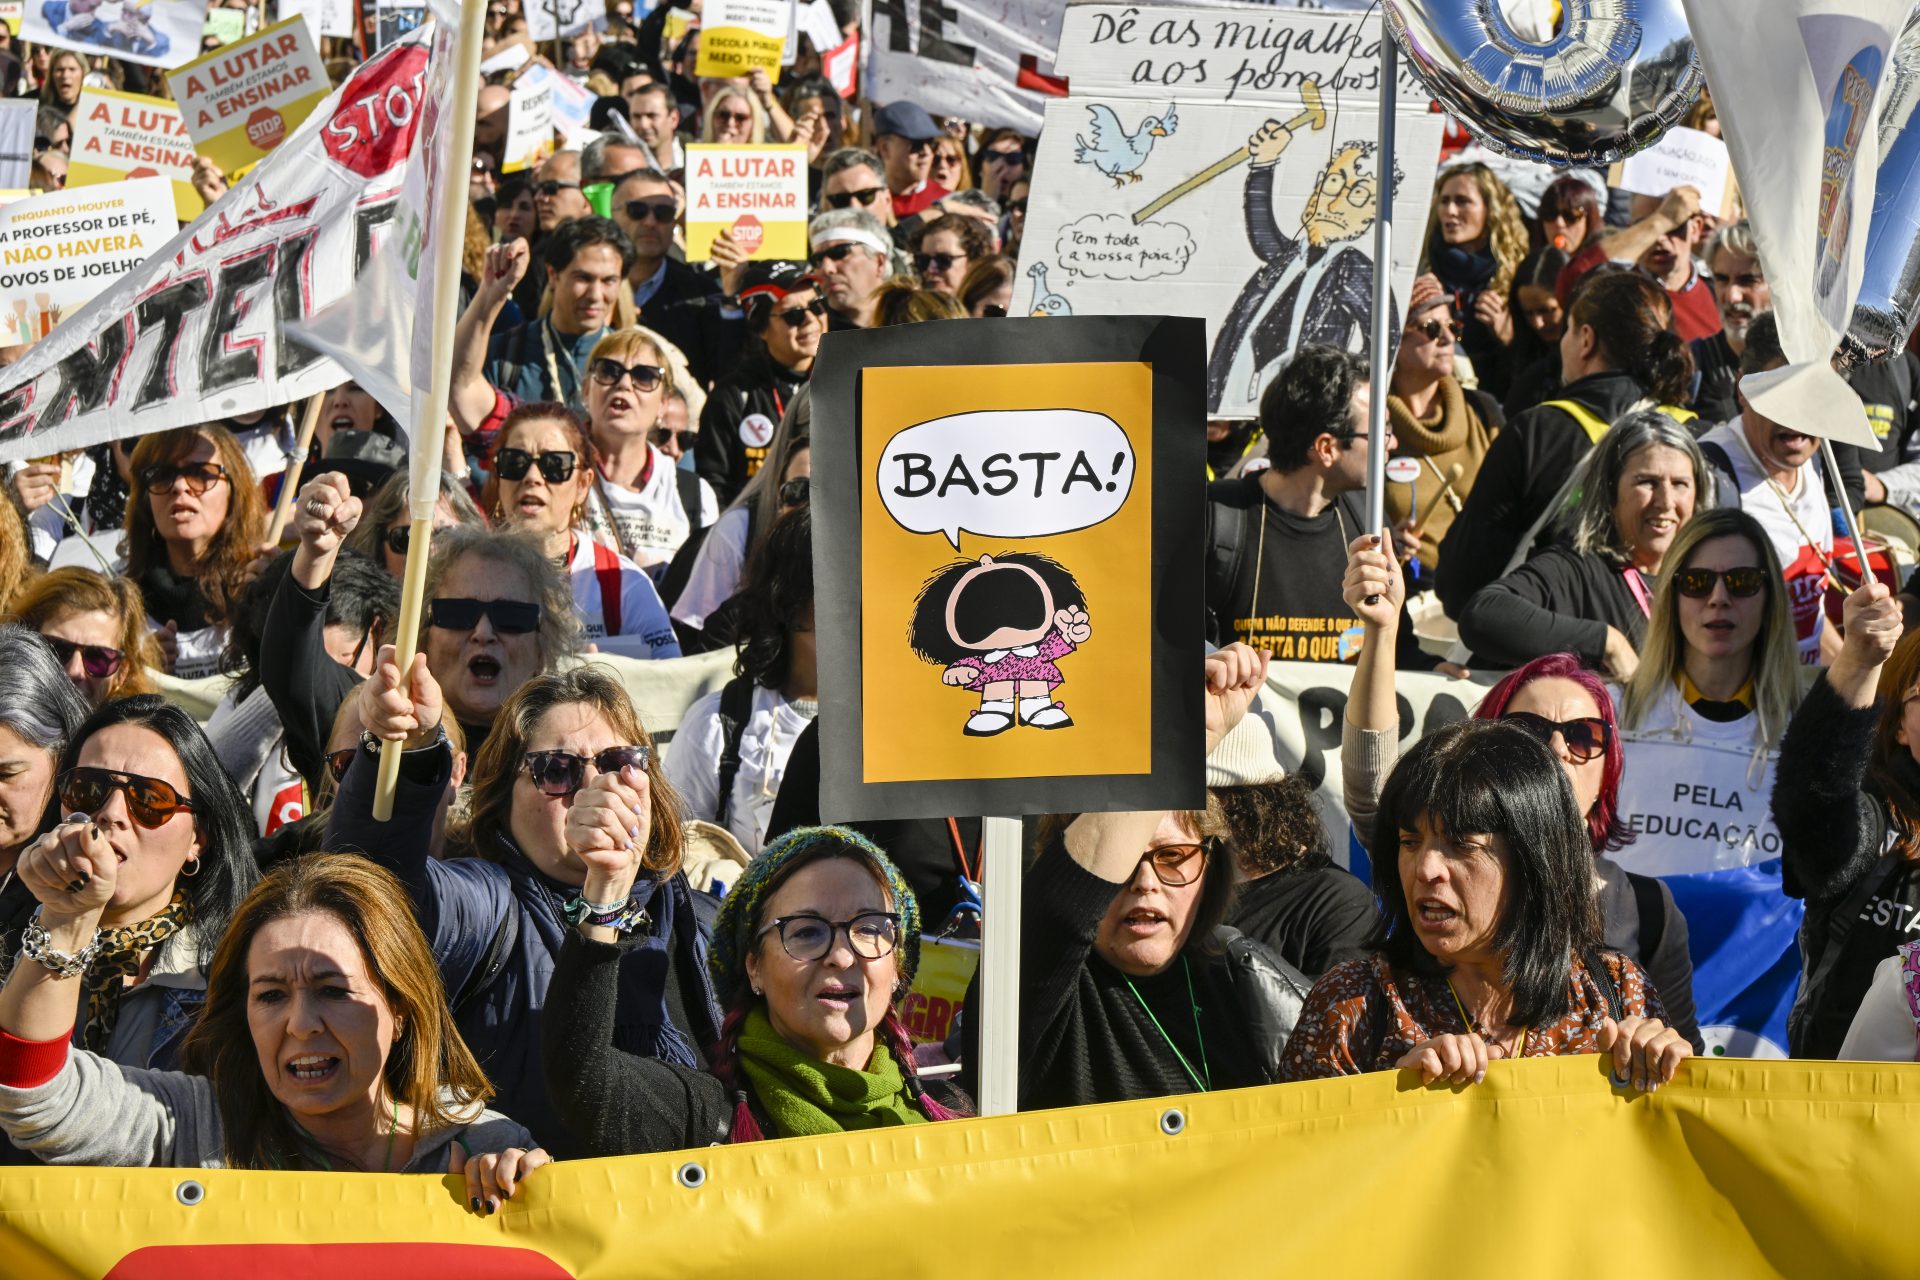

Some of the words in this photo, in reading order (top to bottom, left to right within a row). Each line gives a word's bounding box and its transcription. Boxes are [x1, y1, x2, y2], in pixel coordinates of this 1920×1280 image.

[709, 37, 749, 48] ESCOLA
[1090, 8, 1139, 44] Dê
[1150, 19, 1200, 47] as
[1214, 19, 1384, 73] migalha
[186, 75, 206, 98] A
[209, 33, 299, 86] LUTAR
[709, 52, 742, 64] MEIO
[246, 61, 288, 86] ESTAMOS
[1131, 59, 1207, 85] aos
[198, 110, 214, 128] A
[216, 66, 311, 118] ENSINAR
[89, 102, 112, 124] A
[84, 136, 102, 153] A
[149, 136, 193, 151] ESTAMO
[697, 158, 714, 177] A
[721, 158, 796, 177] LUTAR
[11, 205, 76, 223] ENQUANTO
[78, 199, 125, 213] HOUVER
[697, 192, 710, 208] A
[716, 192, 797, 208] ENSINAR
[13, 219, 103, 240] PROFESSOR
[108, 214, 128, 228] DE
[132, 208, 156, 225] PÉ,
[4, 243, 53, 265] NÃO
[58, 229, 143, 258] HAVERÁ
[1104, 232, 1140, 246] toda
[1069, 251, 1080, 261] a
[1086, 251, 1134, 261] nossa
[54, 266, 76, 282] DE
[893, 450, 1125, 498] BASTA!
[1266, 615, 1287, 631] NÃO
[1288, 617, 1325, 631] DEFENDE
[1327, 617, 1333, 631] O
[1297, 636, 1308, 659] O
[1310, 637, 1339, 661] QUE
[1673, 783, 1743, 812] PELA
[1629, 813, 1780, 853] EDUCAÇÃO
